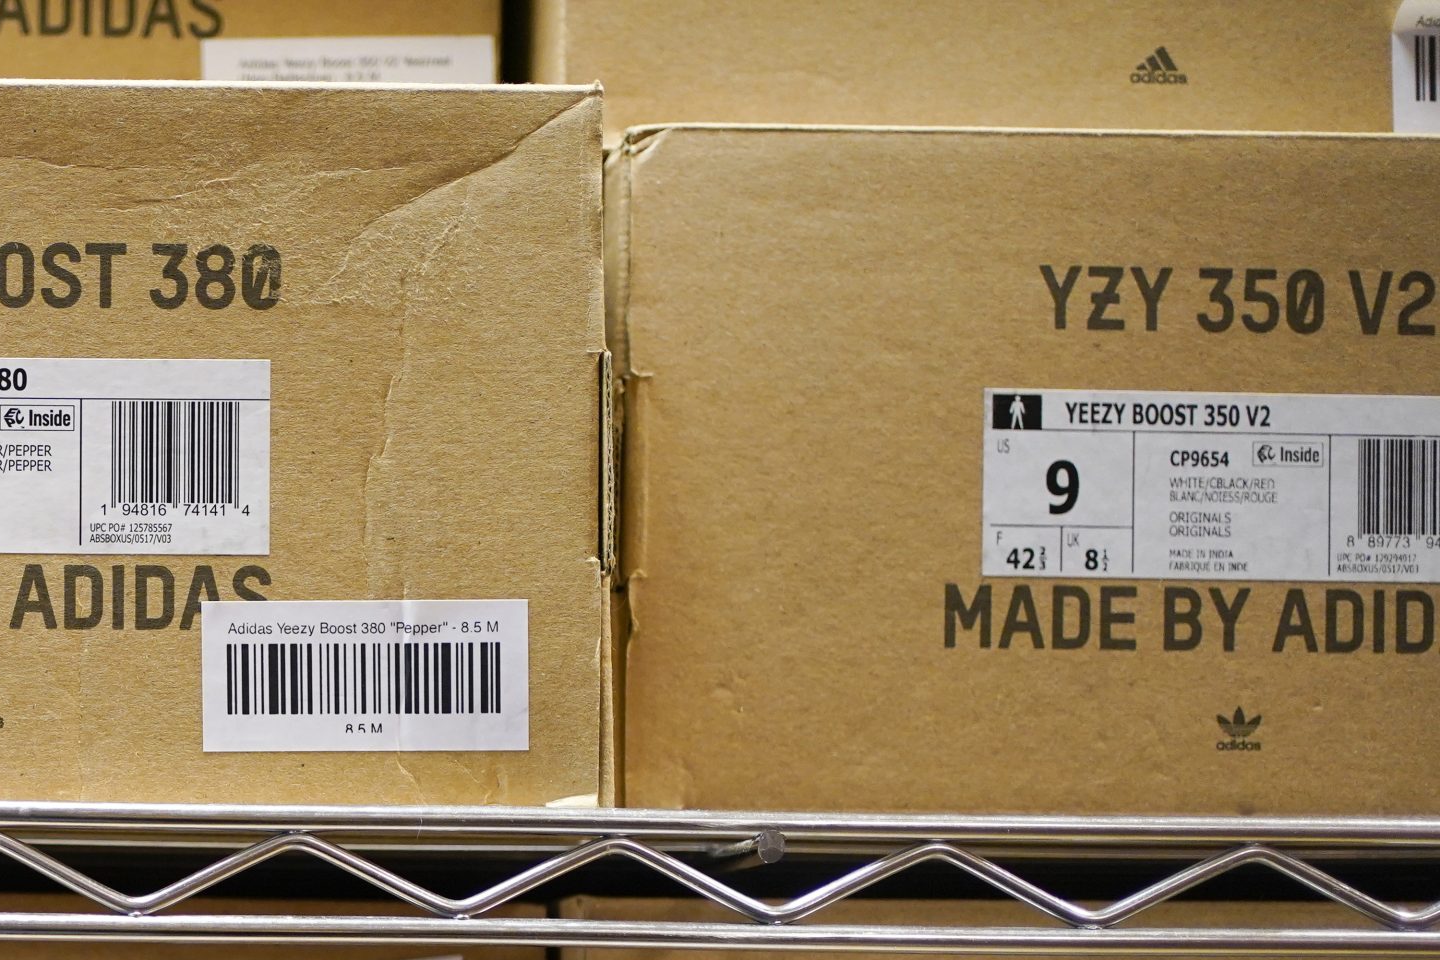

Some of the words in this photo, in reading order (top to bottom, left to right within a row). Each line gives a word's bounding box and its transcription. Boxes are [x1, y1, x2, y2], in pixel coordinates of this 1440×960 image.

[1130, 71, 1187, 84] adidas
[151, 243, 280, 311] 380
[1040, 265, 1173, 331] YZY
[1197, 268, 1325, 335] 350
[1349, 271, 1436, 335] V2
[29, 410, 71, 427] Inside
[1066, 402, 1125, 424] YEEZY
[1133, 404, 1197, 426] BOOST
[1204, 406, 1240, 427] 350
[1245, 406, 1269, 427] V2
[998, 439, 1010, 453] US
[1170, 451, 1229, 467] CP9654
[1281, 447, 1320, 463] Inside
[1046, 460, 1079, 514] 9
[122, 504, 166, 516] 94816
[183, 504, 226, 516] 74141
[1169, 512, 1231, 524] ORIGINALS
[90, 523, 106, 532] UPC
[109, 523, 126, 532] PO#
[1169, 526, 1231, 537] ORIGINALS
[997, 531, 1002, 545] F
[1067, 533, 1079, 547] UK
[1006, 548, 1035, 570] 42
[1085, 549, 1098, 570] 8
[944, 583, 1137, 650] MADE
[1163, 586, 1250, 652] BY
[1272, 588, 1440, 654] ADID
[228, 623, 273, 634] Adidas
[277, 623, 315, 636] Yeezy
[320, 623, 357, 634] Boost
[362, 623, 385, 634] 380
[461, 622, 482, 633] 8.5
[487, 621, 499, 632] M
[1216, 740, 1261, 751] adidas
